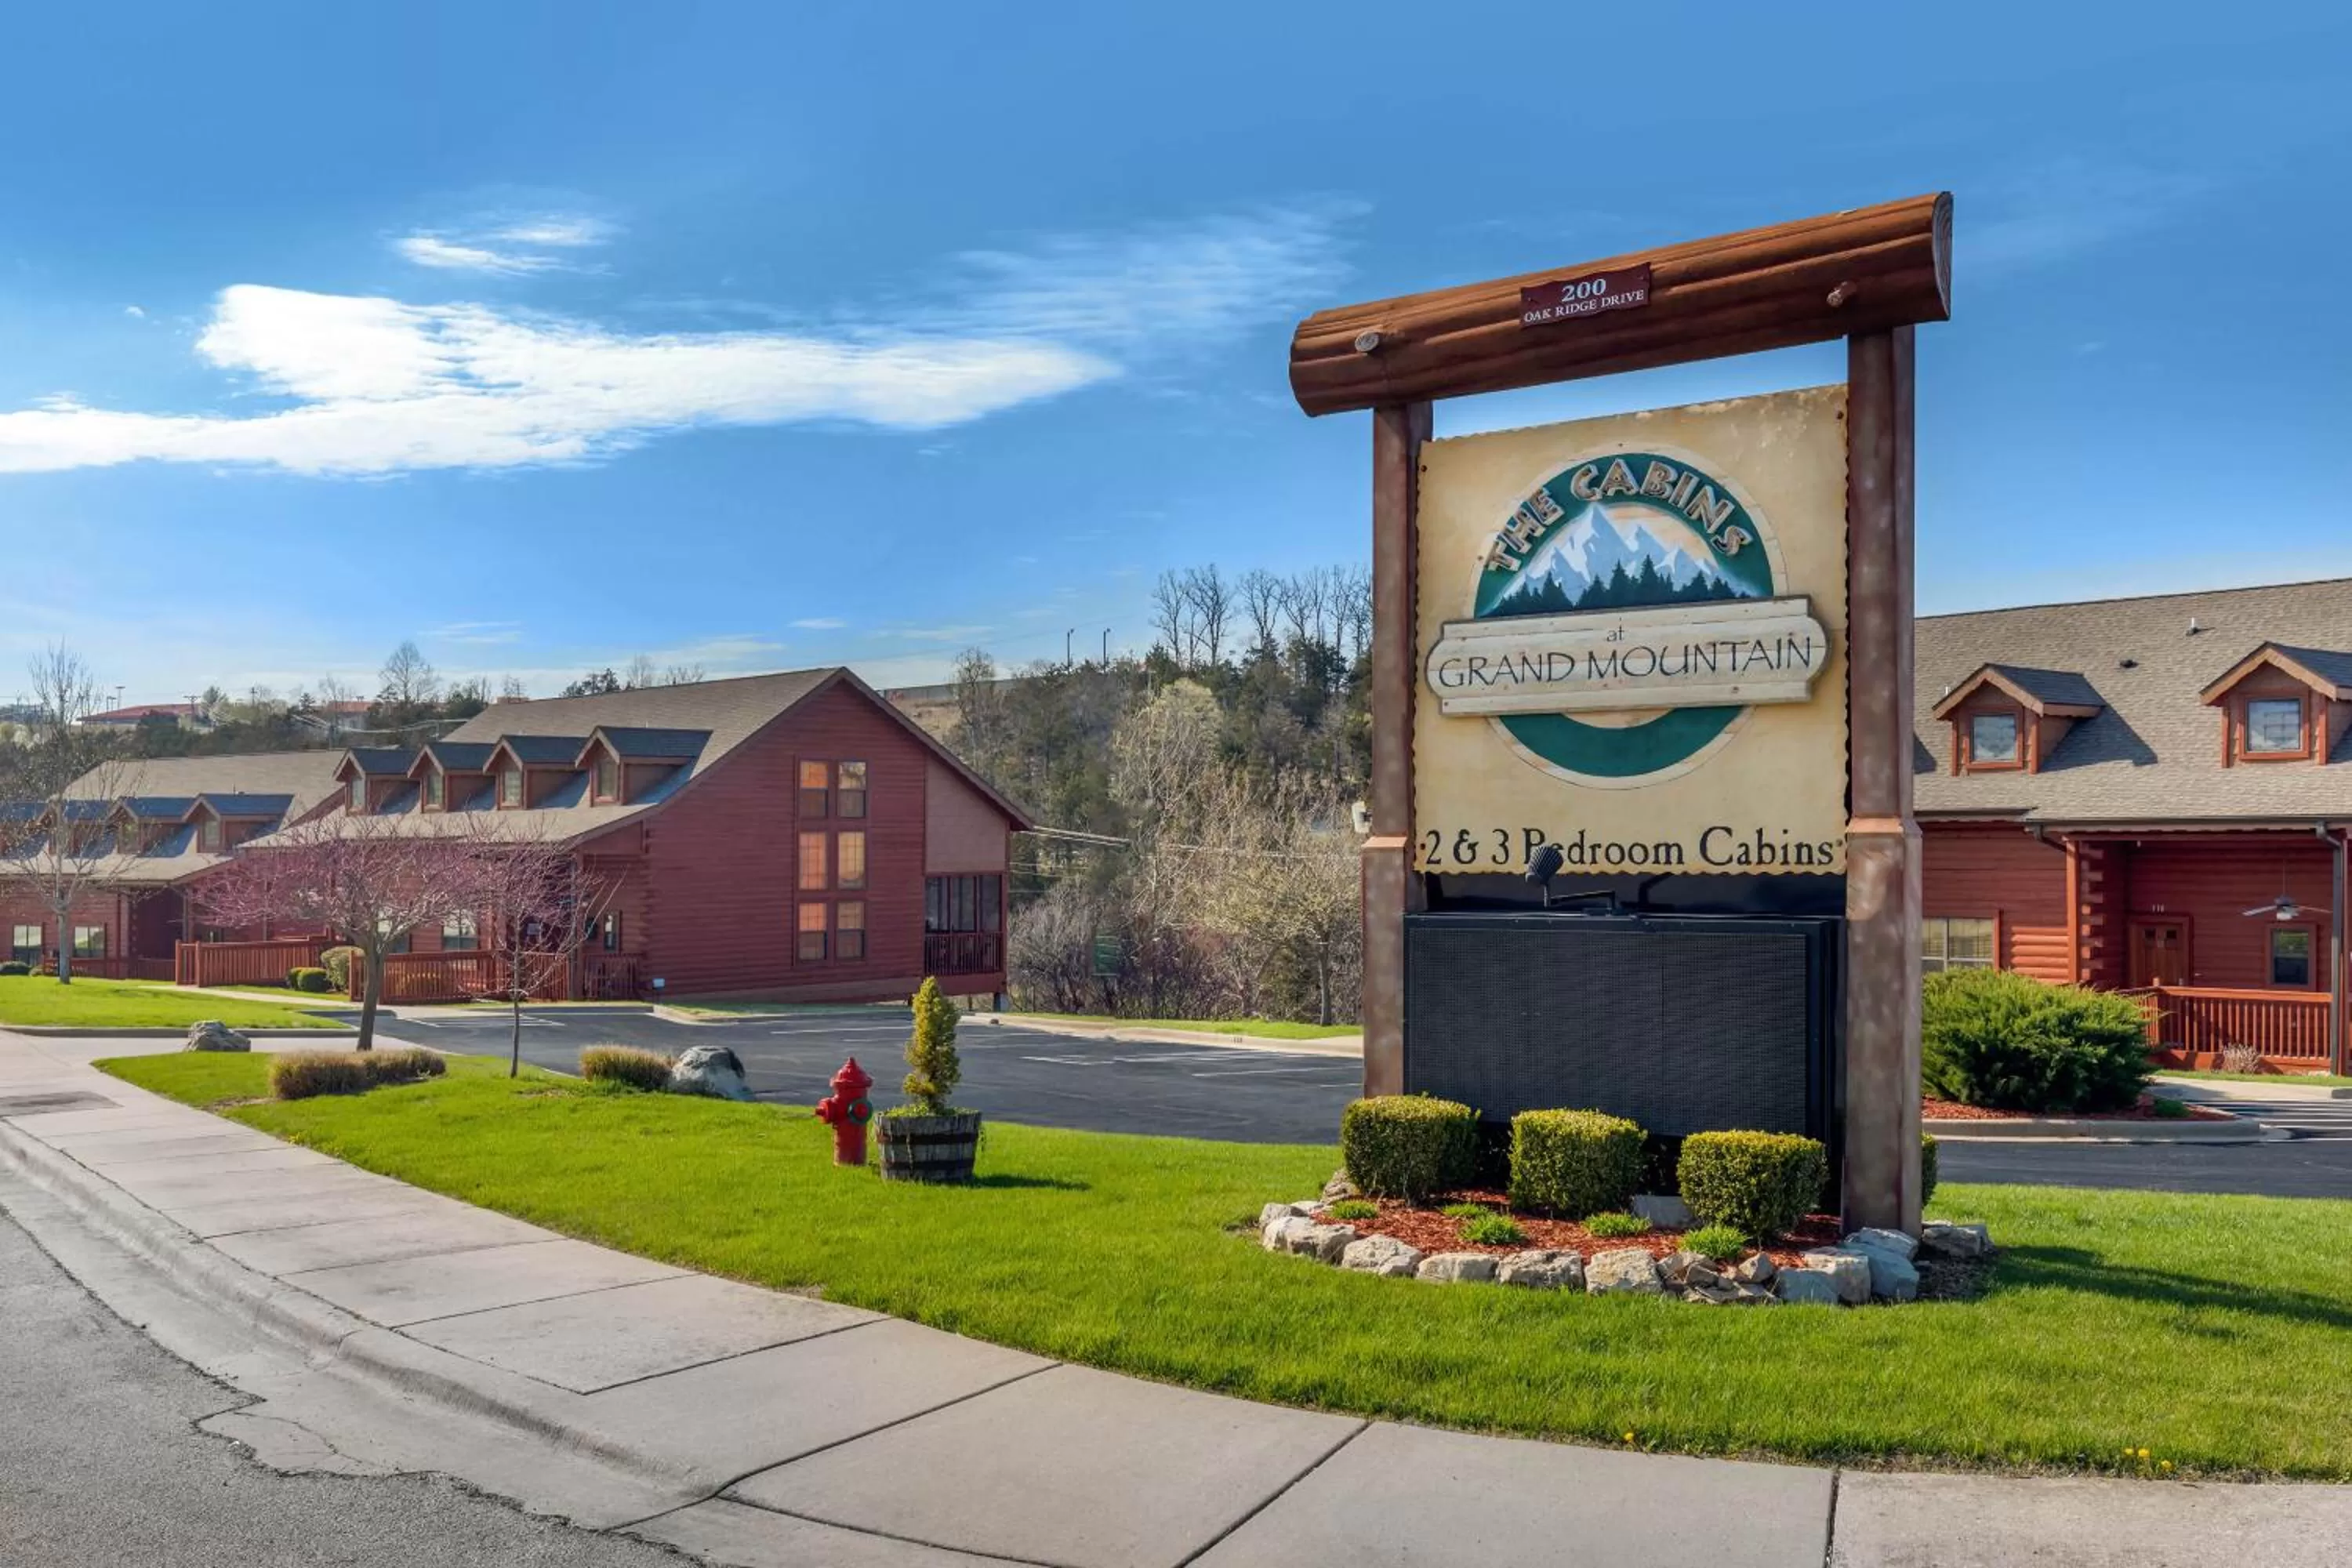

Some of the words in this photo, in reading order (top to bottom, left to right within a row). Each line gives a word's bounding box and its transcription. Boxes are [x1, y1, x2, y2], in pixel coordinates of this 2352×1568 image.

[1524, 308, 1552, 323] OAK
[1555, 299, 1597, 317] RIDGE
[1601, 289, 1644, 307] DRIVE
[1561, 278, 1606, 303] 200
[1487, 485, 1566, 573] THE
[1570, 457, 1754, 557] CABINS
[1606, 625, 1625, 643] at
[1438, 652, 1576, 689] GRAND
[1587, 636, 1812, 680] MOUNTAIN
[1425, 829, 1443, 865] 2
[1453, 828, 1479, 865] &
[1491, 828, 1510, 865] 3
[1699, 825, 1835, 867] Cabins
